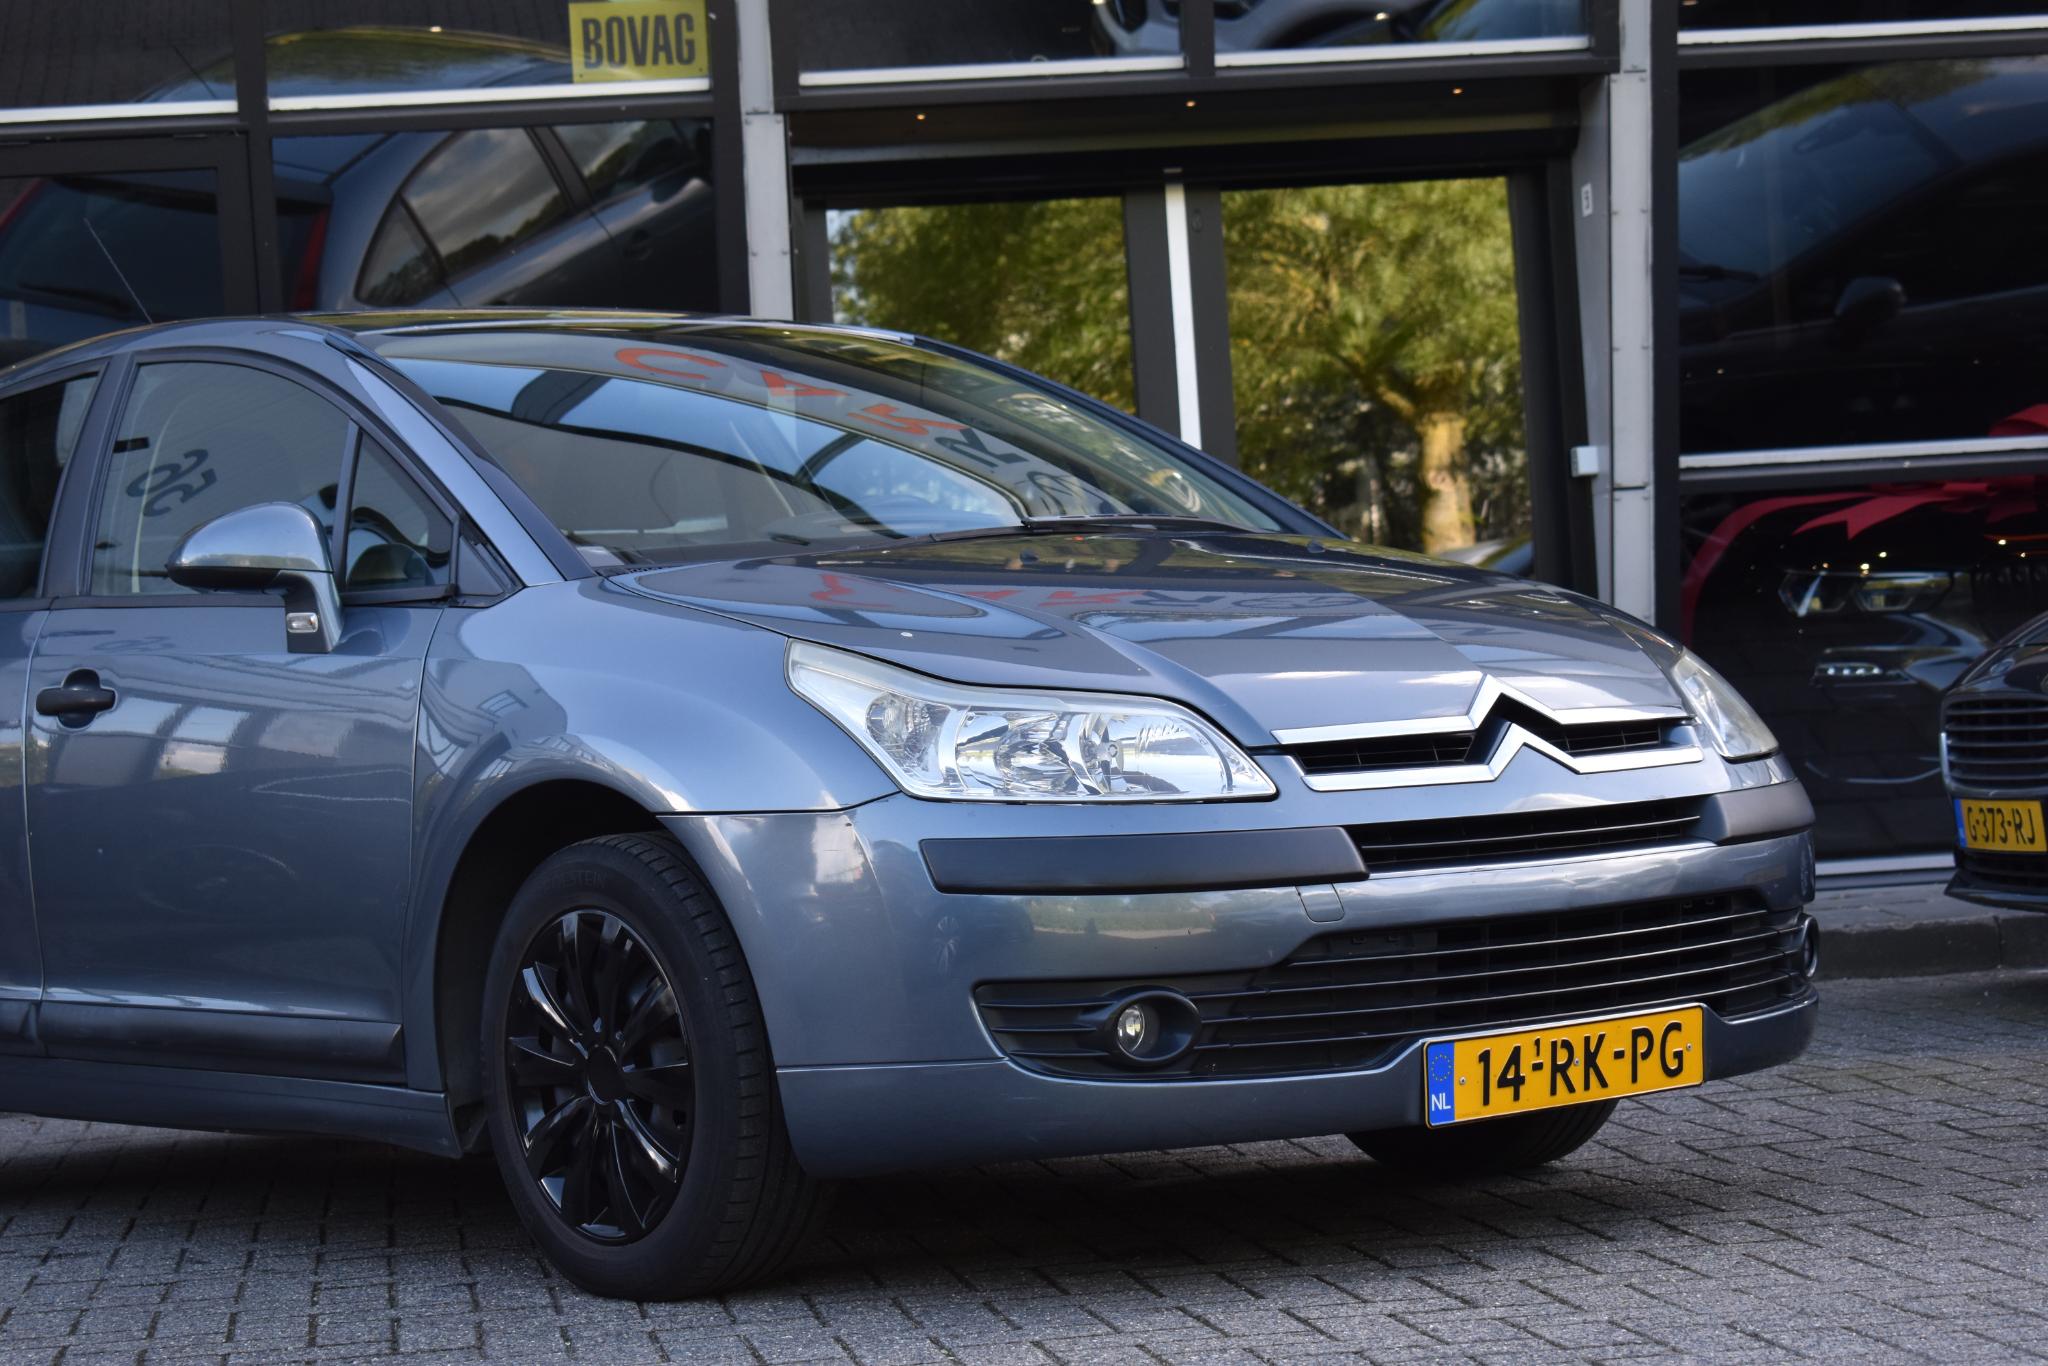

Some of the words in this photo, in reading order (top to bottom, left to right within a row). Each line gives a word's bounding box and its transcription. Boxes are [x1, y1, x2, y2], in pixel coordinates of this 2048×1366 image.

[581, 13, 696, 69] BOVAG
[1967, 806, 2036, 845] G-373-RJ
[1431, 1092, 1452, 1112] NL
